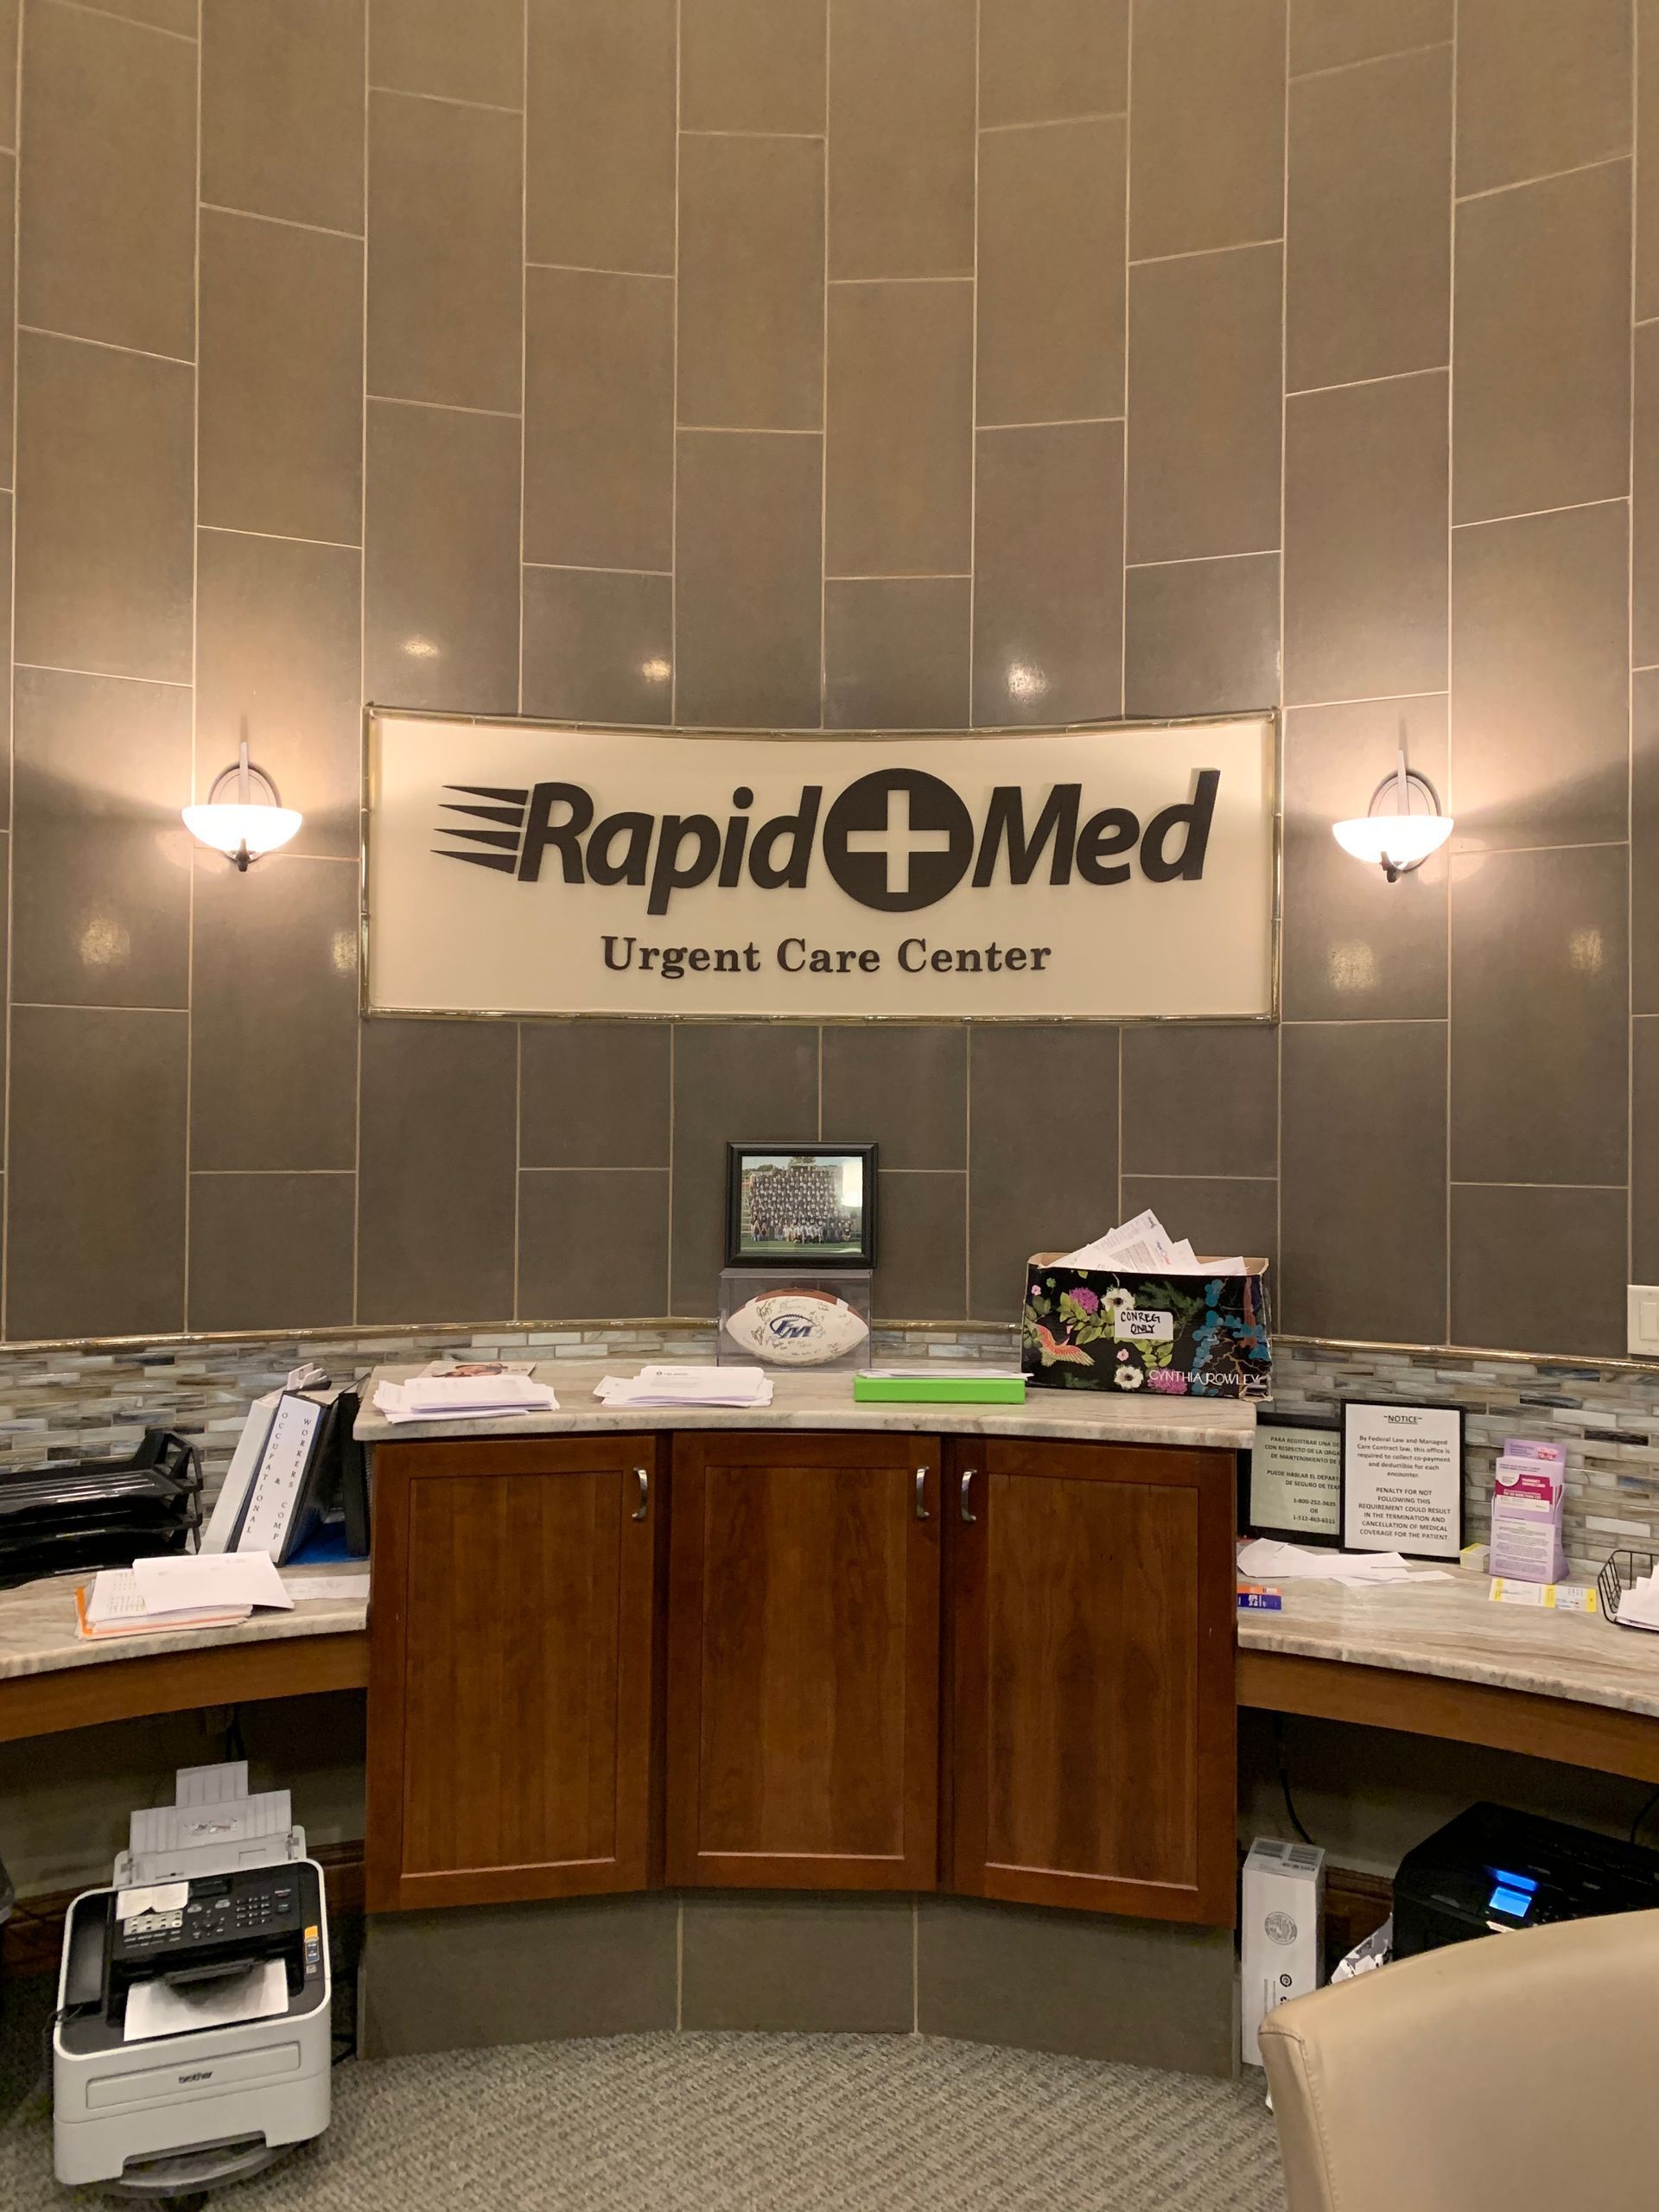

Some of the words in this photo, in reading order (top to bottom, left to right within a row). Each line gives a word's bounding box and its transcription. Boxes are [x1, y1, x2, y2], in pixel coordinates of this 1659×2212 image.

[518, 782, 823, 915] Rapid
[971, 767, 1221, 887] Med
[601, 935, 760, 979] Urgent
[778, 938, 880, 973] Care
[898, 938, 1051, 973] Center
[1130, 1324, 1155, 1335] ONLY
[1148, 1370, 1204, 1384] CYNTHIA
[1205, 1372, 1261, 1386] ROWLEY
[289, 1418, 312, 1488] WORKERS
[1280, 1454, 1328, 1464] MANTENIMIENTO
[246, 1412, 289, 1534] OCCUPATIONAL
[1358, 1503, 1403, 1511] REQUIREMENT
[272, 1502, 288, 1541] COMP
[179, 2071, 213, 2084] brother
